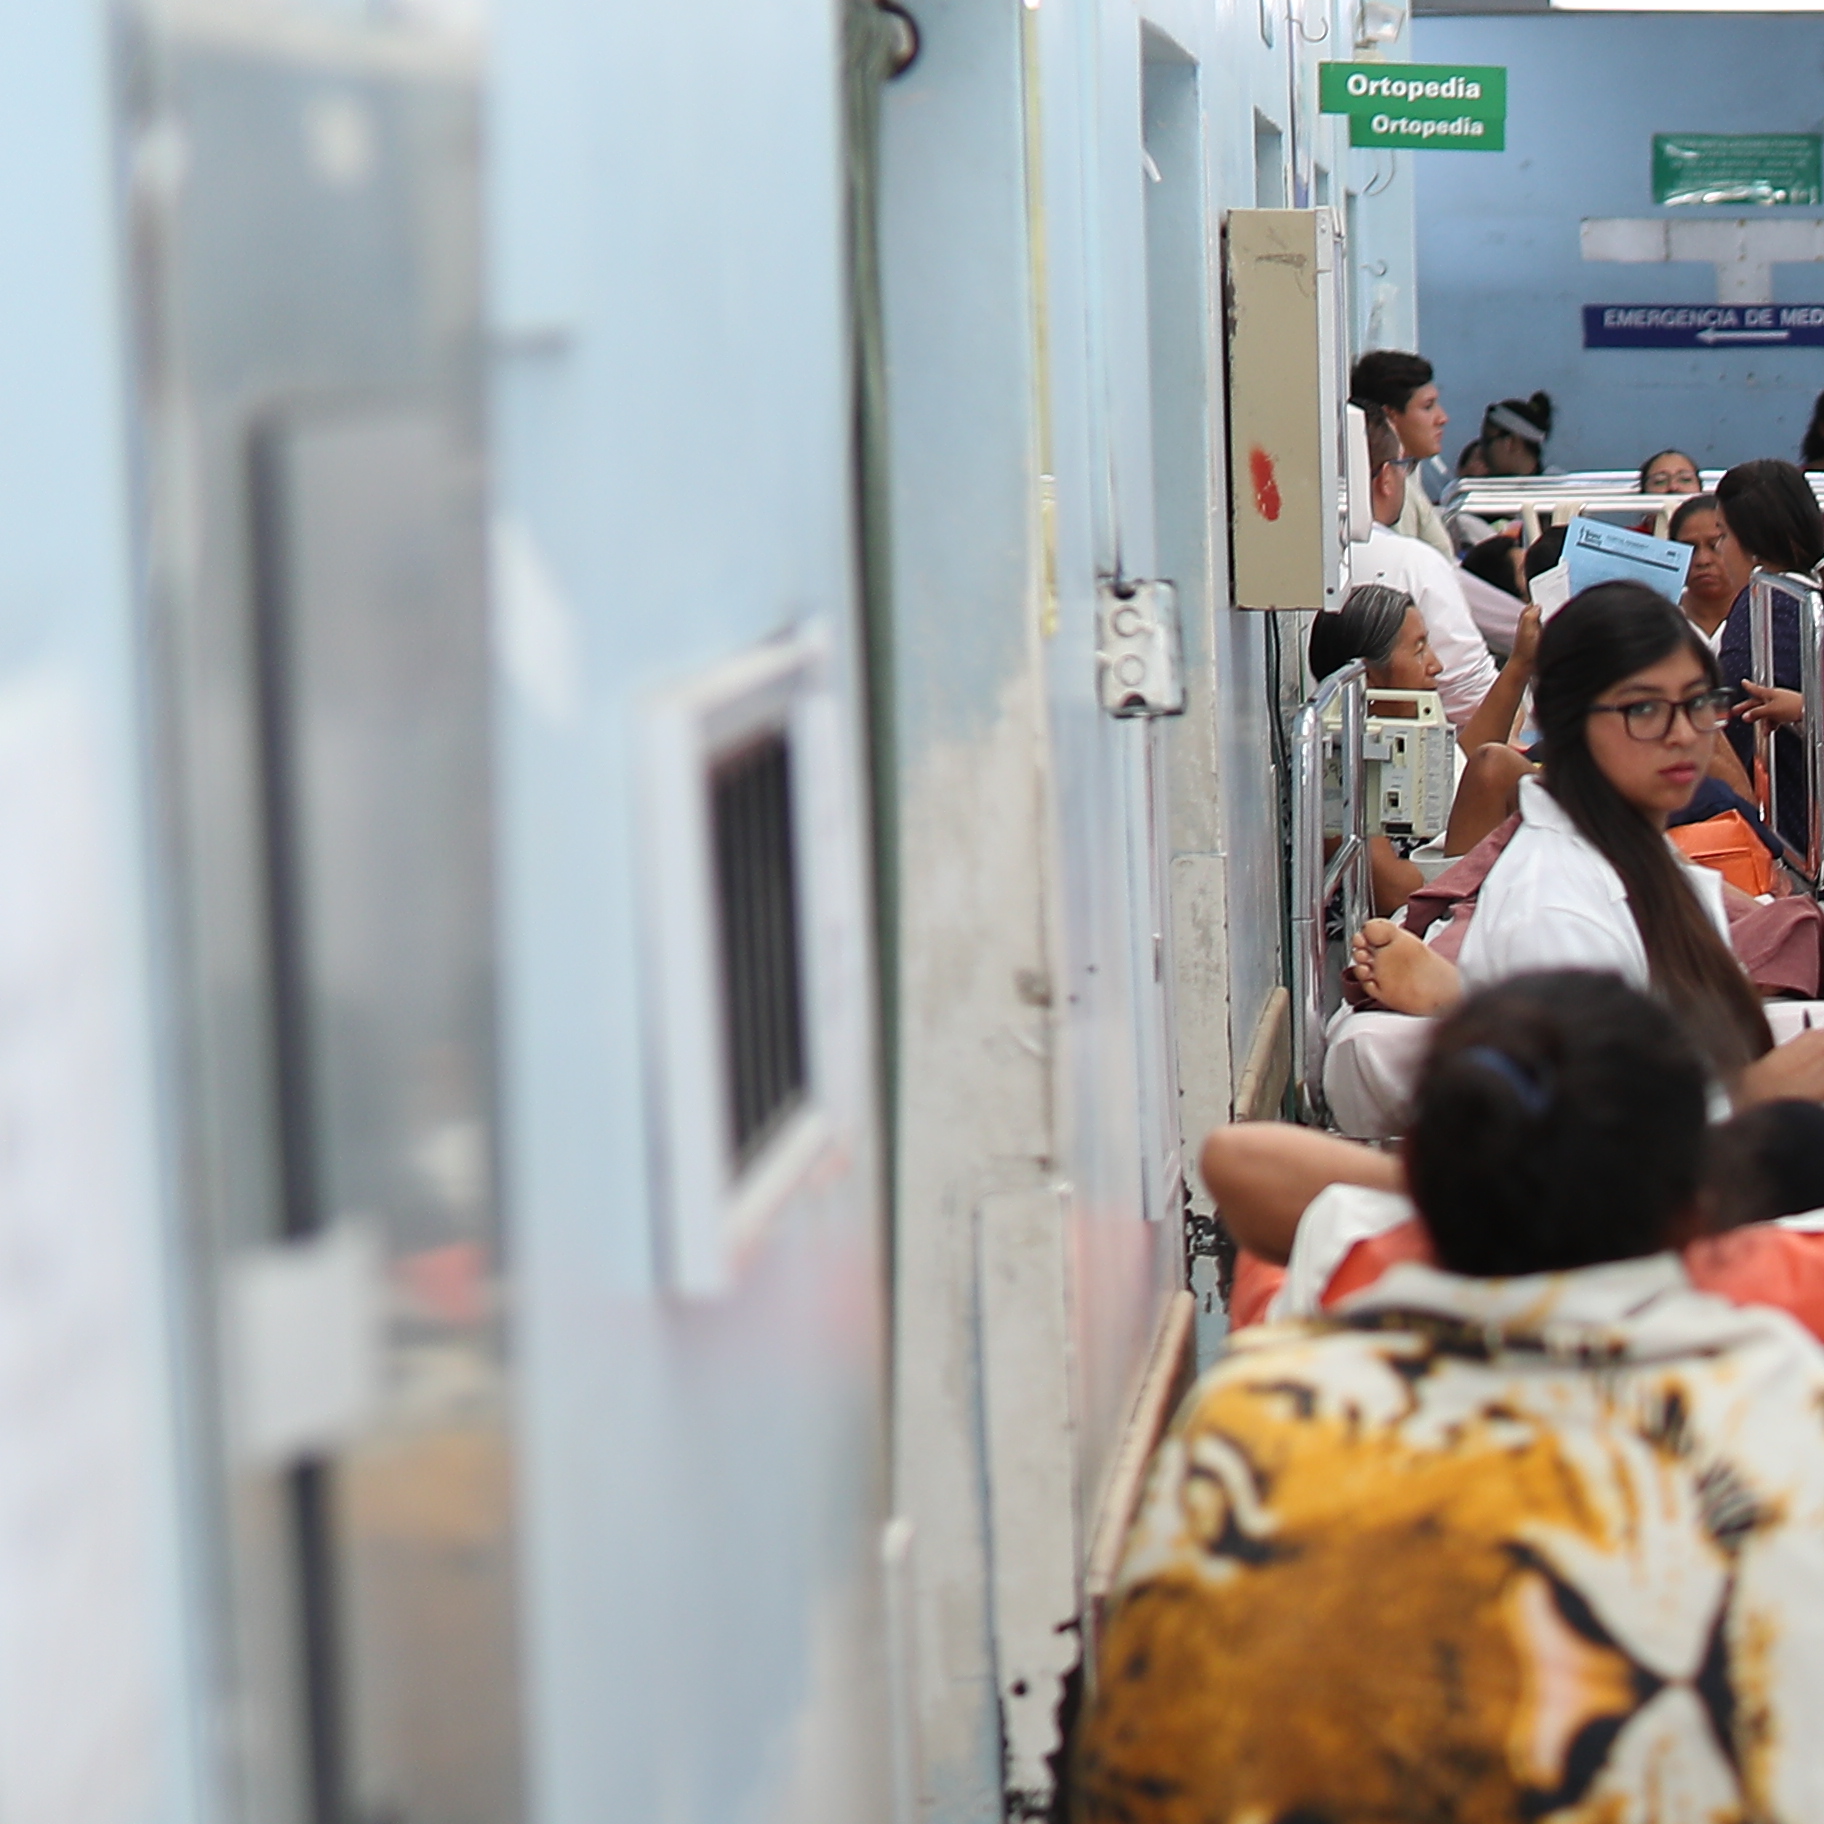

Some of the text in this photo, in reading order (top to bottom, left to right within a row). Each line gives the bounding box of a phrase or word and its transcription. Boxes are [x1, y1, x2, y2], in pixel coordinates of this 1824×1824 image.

[1347, 73, 1482, 101] Ortopedia
[1371, 114, 1485, 139] Ortopedia
[1603, 307, 1739, 327] EMERGENCIA
[1744, 307, 1774, 327] DE
